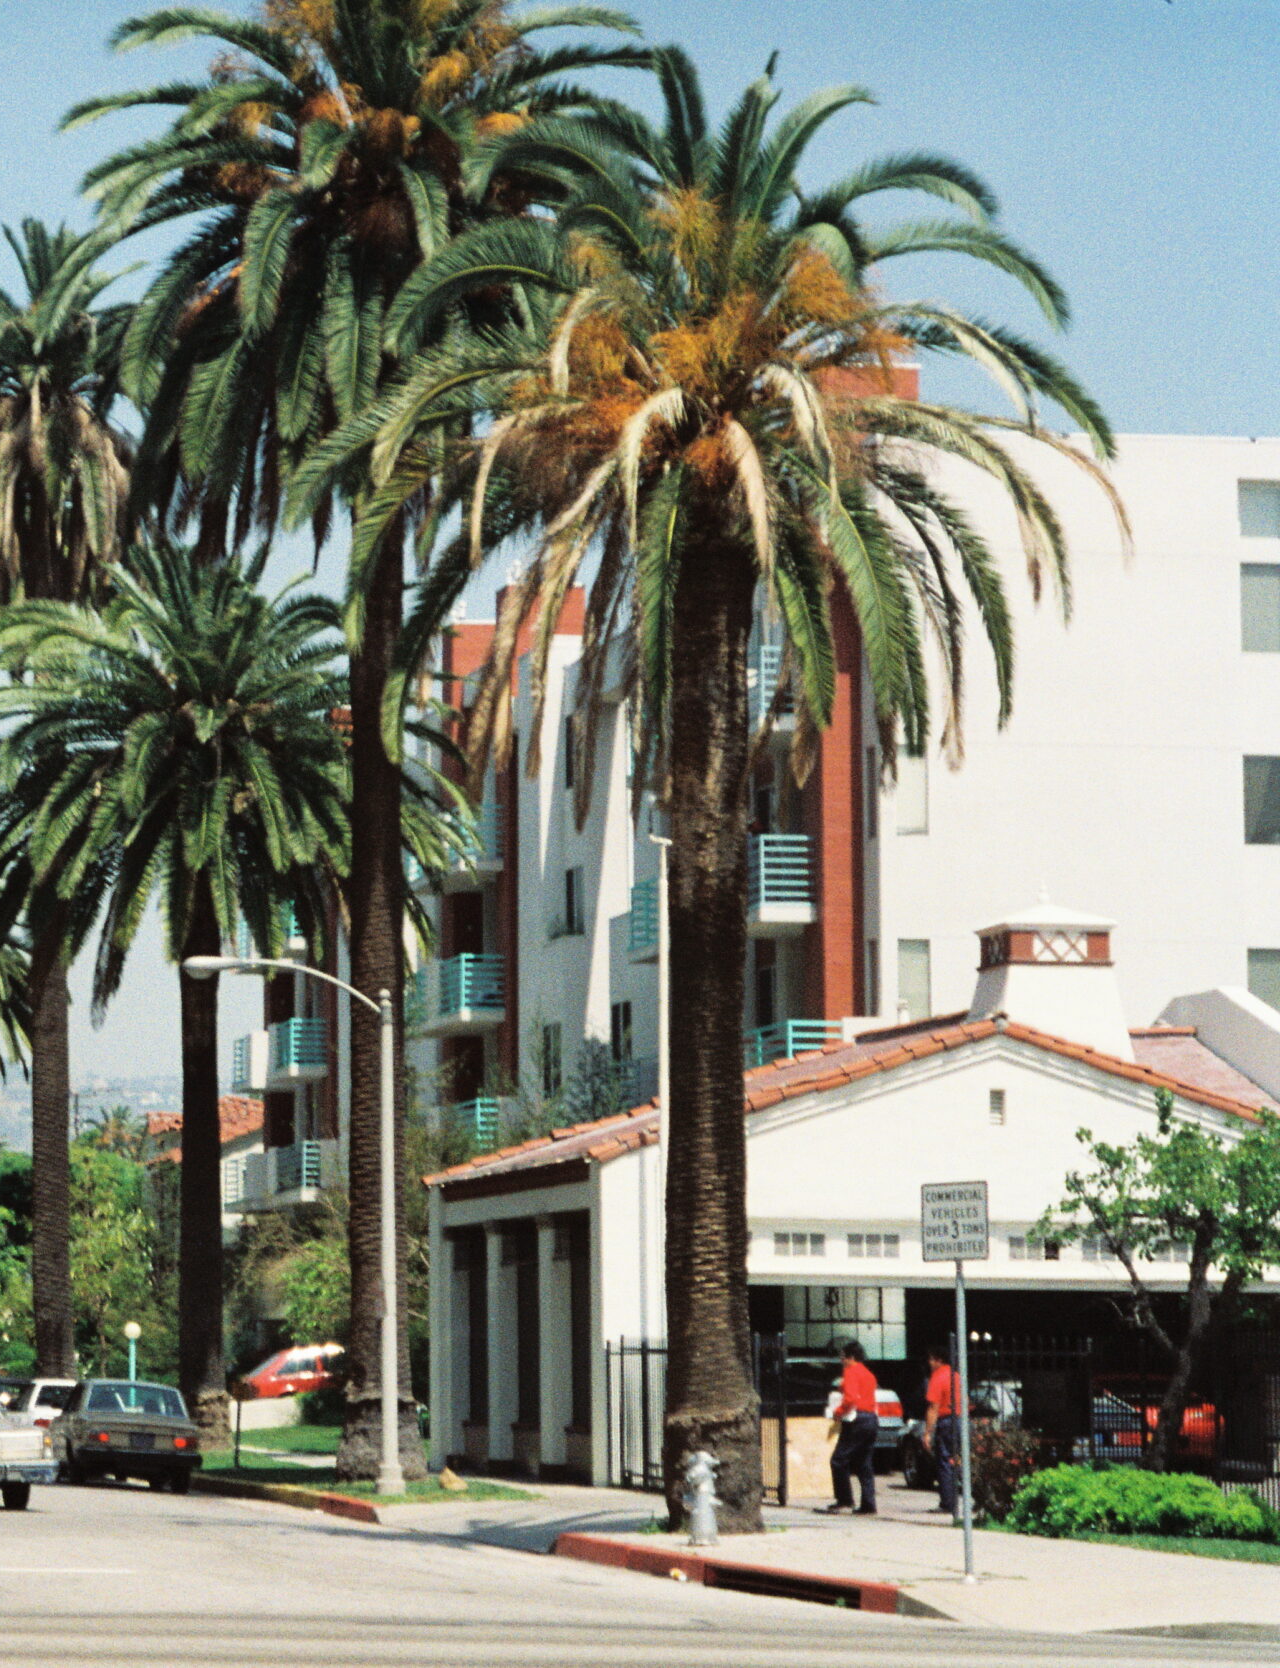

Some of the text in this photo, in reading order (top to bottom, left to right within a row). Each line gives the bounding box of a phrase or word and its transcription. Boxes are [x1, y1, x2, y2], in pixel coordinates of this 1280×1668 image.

[925, 1189, 983, 1203] COMMERCIAL
[931, 1207, 978, 1219] VEHICLES
[926, 1220, 985, 1239] OVER 3 TONS
[926, 1240, 985, 1254] PROHIBITED
